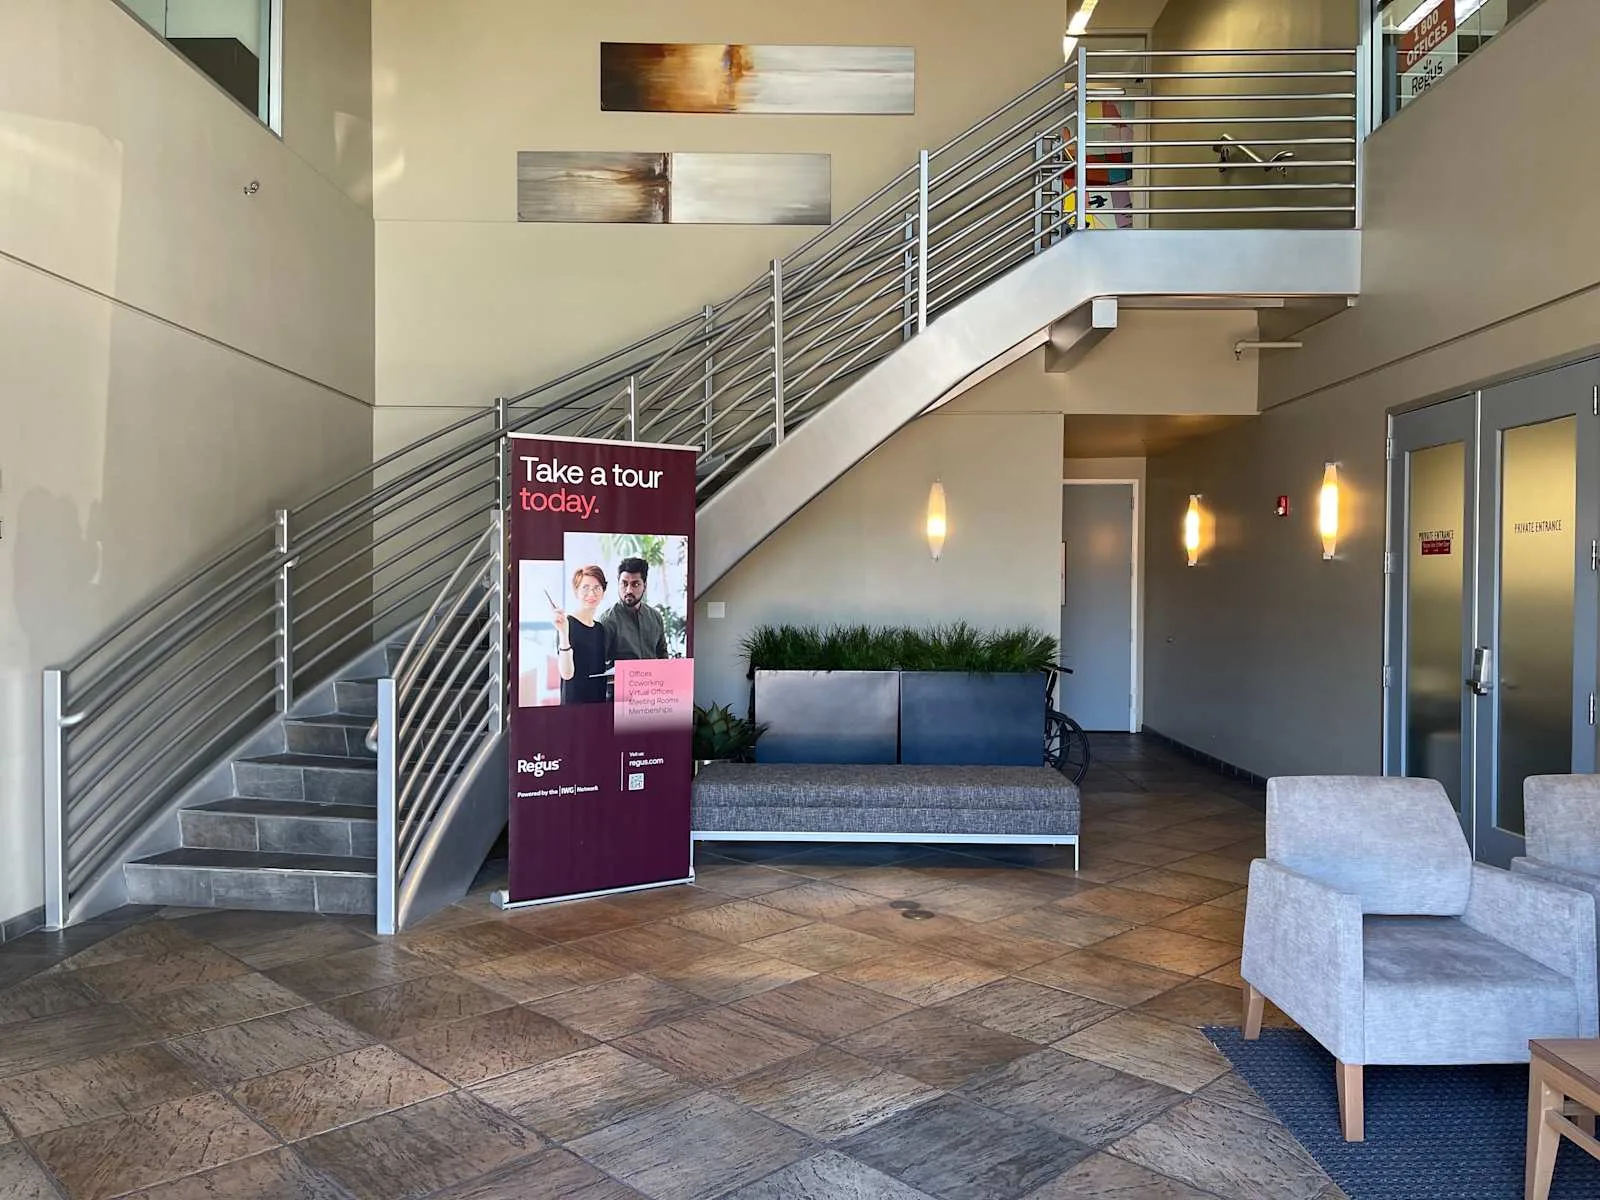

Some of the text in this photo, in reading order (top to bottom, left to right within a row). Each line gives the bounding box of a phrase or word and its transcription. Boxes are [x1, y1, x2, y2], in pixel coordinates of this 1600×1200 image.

[1420, 9, 1439, 36] 800
[1406, 20, 1448, 67] OFFICES
[1411, 60, 1443, 97] Regus
[519, 455, 664, 489] Take a tour
[519, 487, 600, 519] today.
[1514, 519, 1562, 534] PRIVATE ENTRANCE
[628, 670, 653, 678] Offices
[628, 679, 665, 688] Coworking
[628, 688, 674, 697] Virtual Offices
[517, 759, 561, 777] Regus
[628, 757, 664, 768] regus.com
[517, 789, 541, 798] Powered
[541, 789, 549, 797] by
